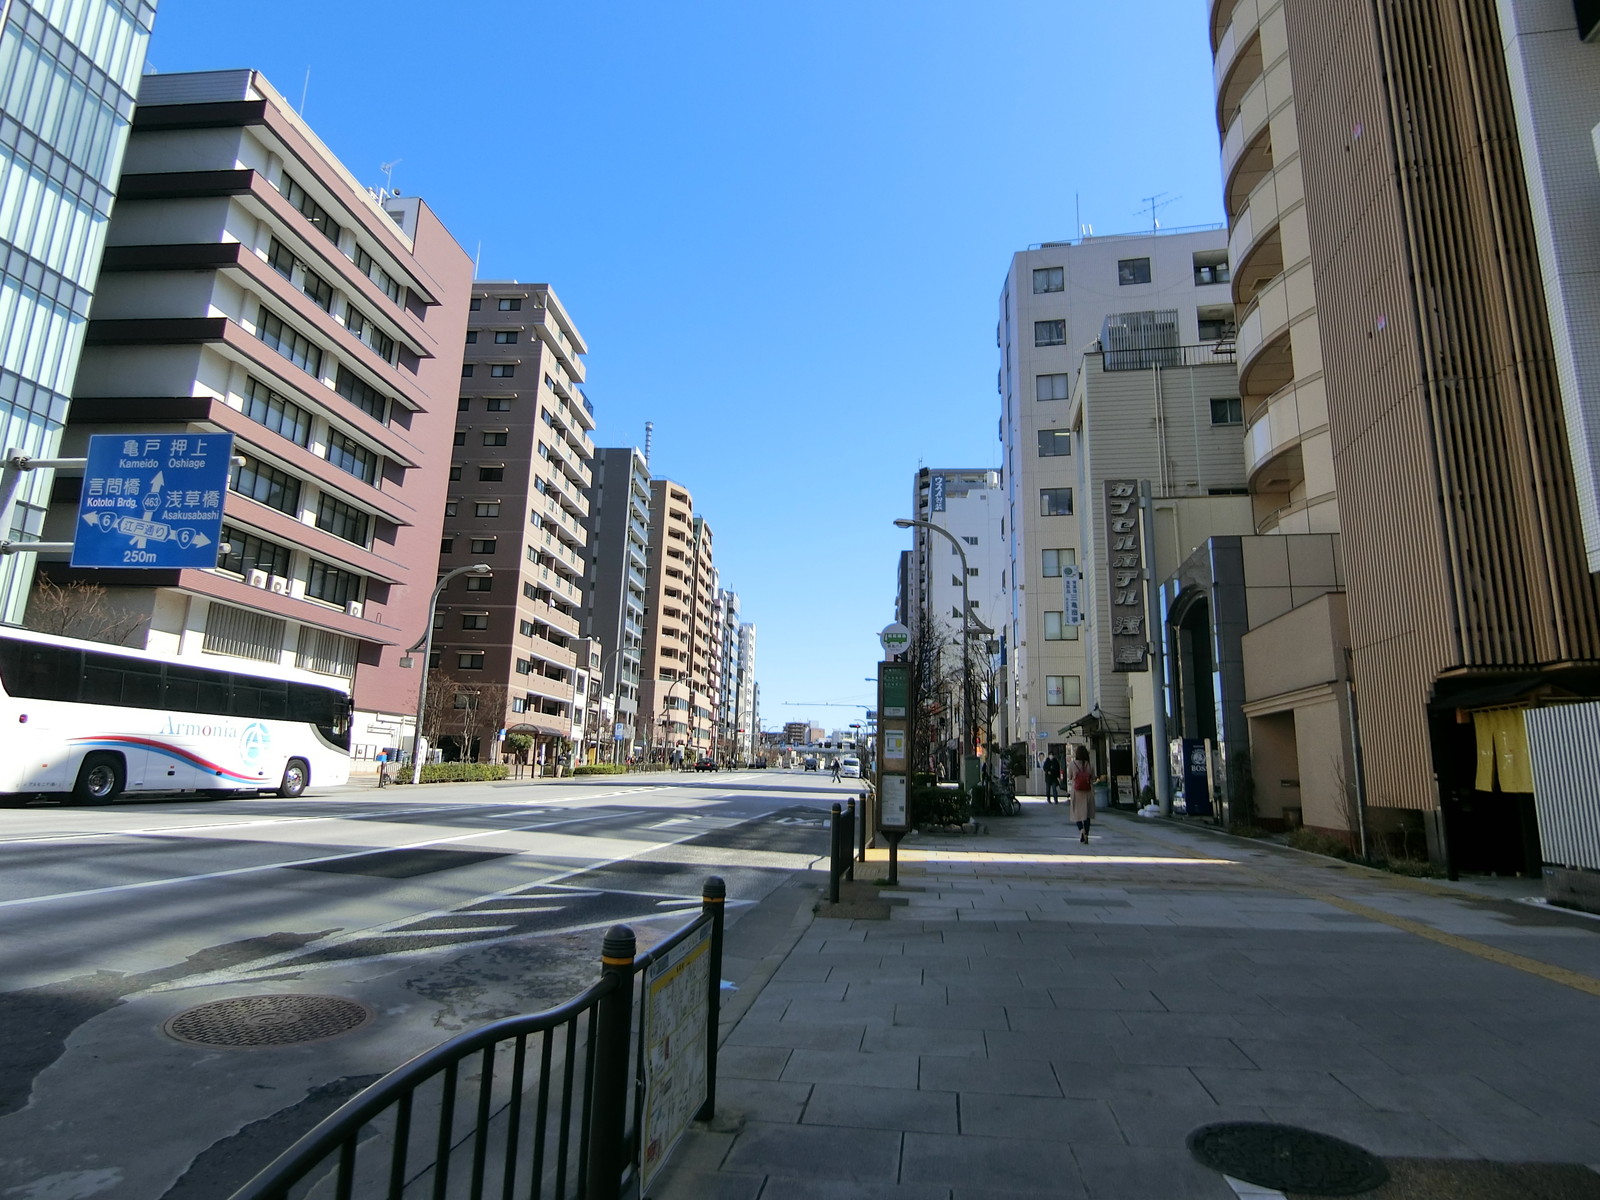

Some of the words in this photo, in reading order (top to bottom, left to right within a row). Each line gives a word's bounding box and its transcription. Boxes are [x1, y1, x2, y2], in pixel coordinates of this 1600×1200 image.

[122, 439, 161, 457] 亀戸
[169, 439, 208, 457] 押上
[119, 458, 159, 468] Kameido
[168, 458, 206, 469] Oshiage
[88, 477, 141, 496] 言問橋
[87, 497, 115, 507] Kototoi
[117, 497, 138, 509] Brdg.
[144, 497, 159, 507] 463
[165, 490, 220, 508] 浅草橋
[102, 515, 111, 526] 6
[162, 510, 220, 520] Asakusabashi
[124, 520, 165, 538] 江戸通り
[181, 531, 190, 543] 6
[123, 551, 157, 563] 250m
[159, 715, 238, 738] Armonia
[1191, 764, 1207, 772] BOS
